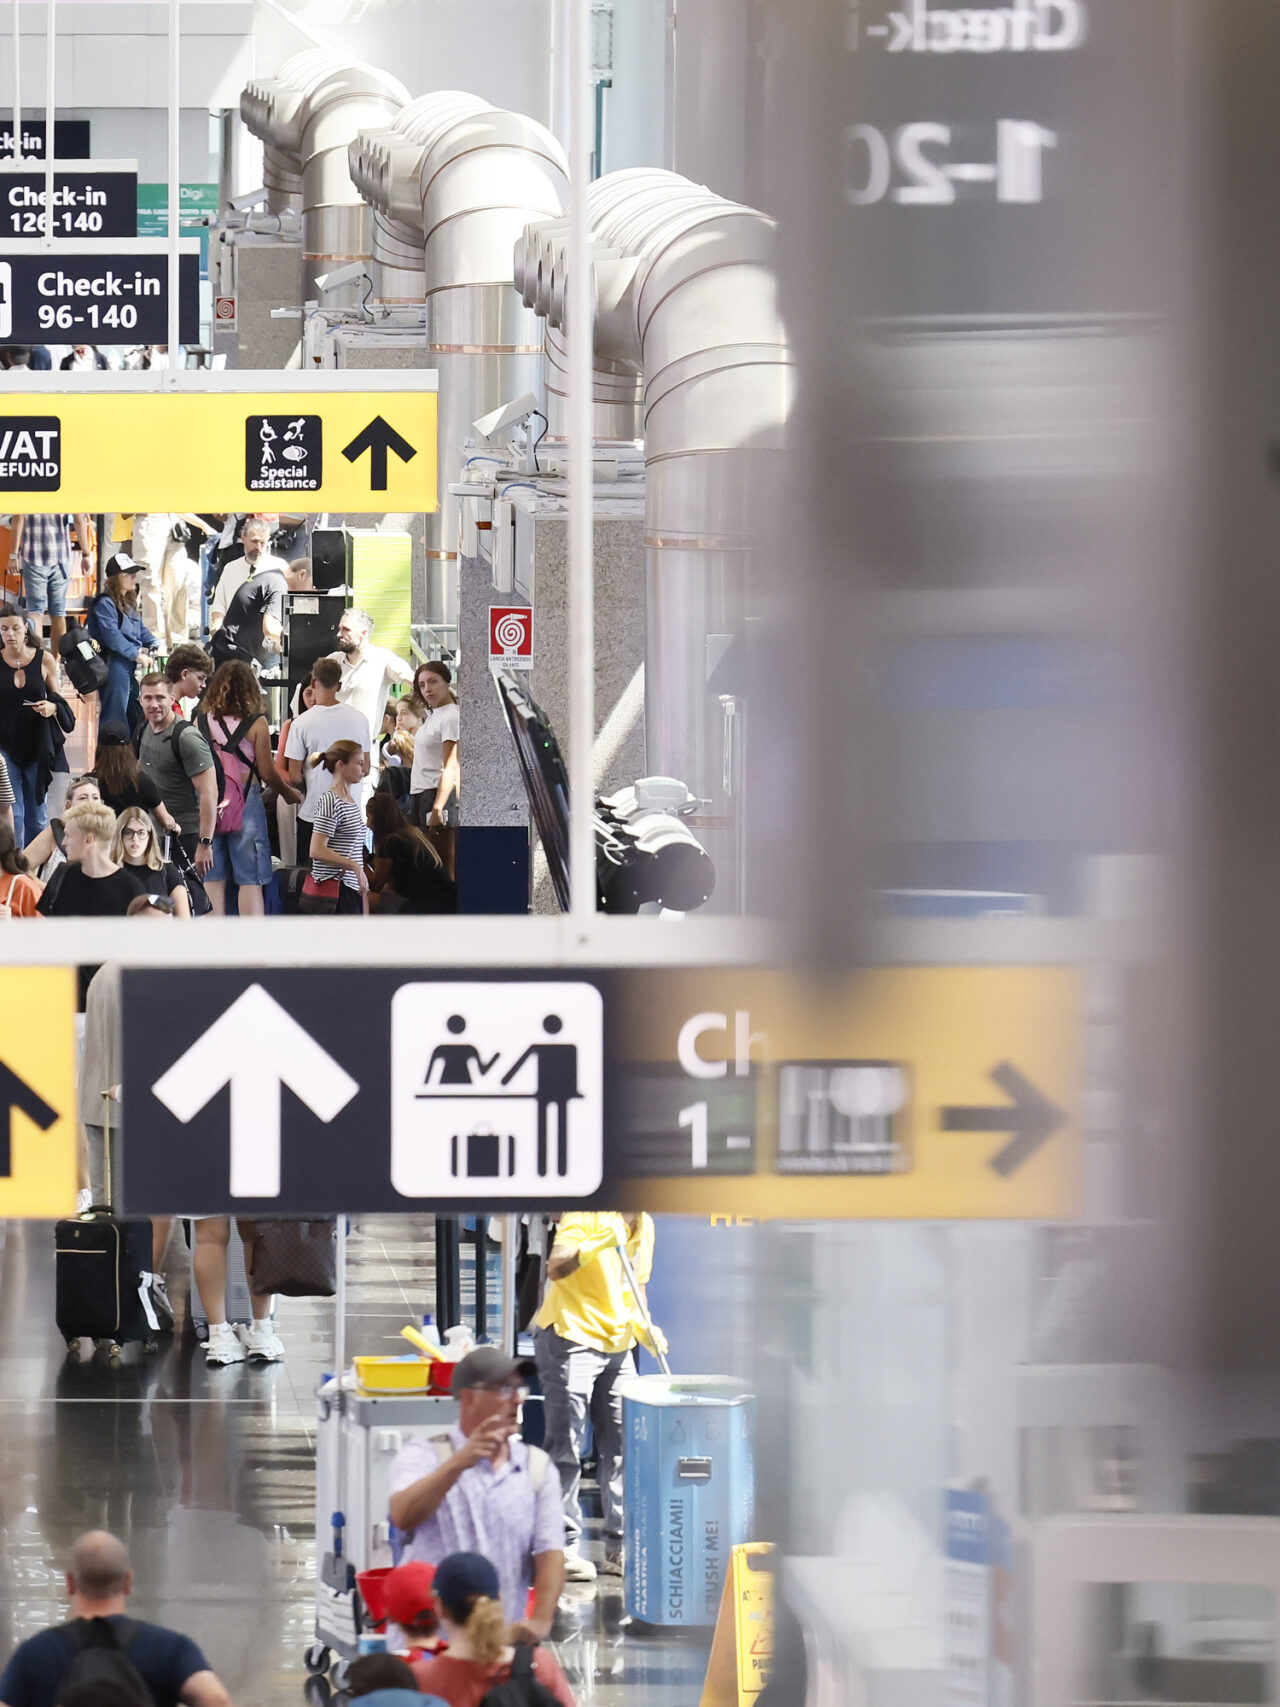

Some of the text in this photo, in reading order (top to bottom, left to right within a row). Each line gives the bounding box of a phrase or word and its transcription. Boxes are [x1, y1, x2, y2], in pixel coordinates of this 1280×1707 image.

[37, 271, 161, 297] Check-in
[38, 305, 138, 329] 96-140
[250, 476, 317, 490] assistance
[260, 465, 308, 482] Special
[669, 1498, 684, 1620] SCHIACCIAMI!
[705, 1520, 720, 1616] CRUSH ME!
